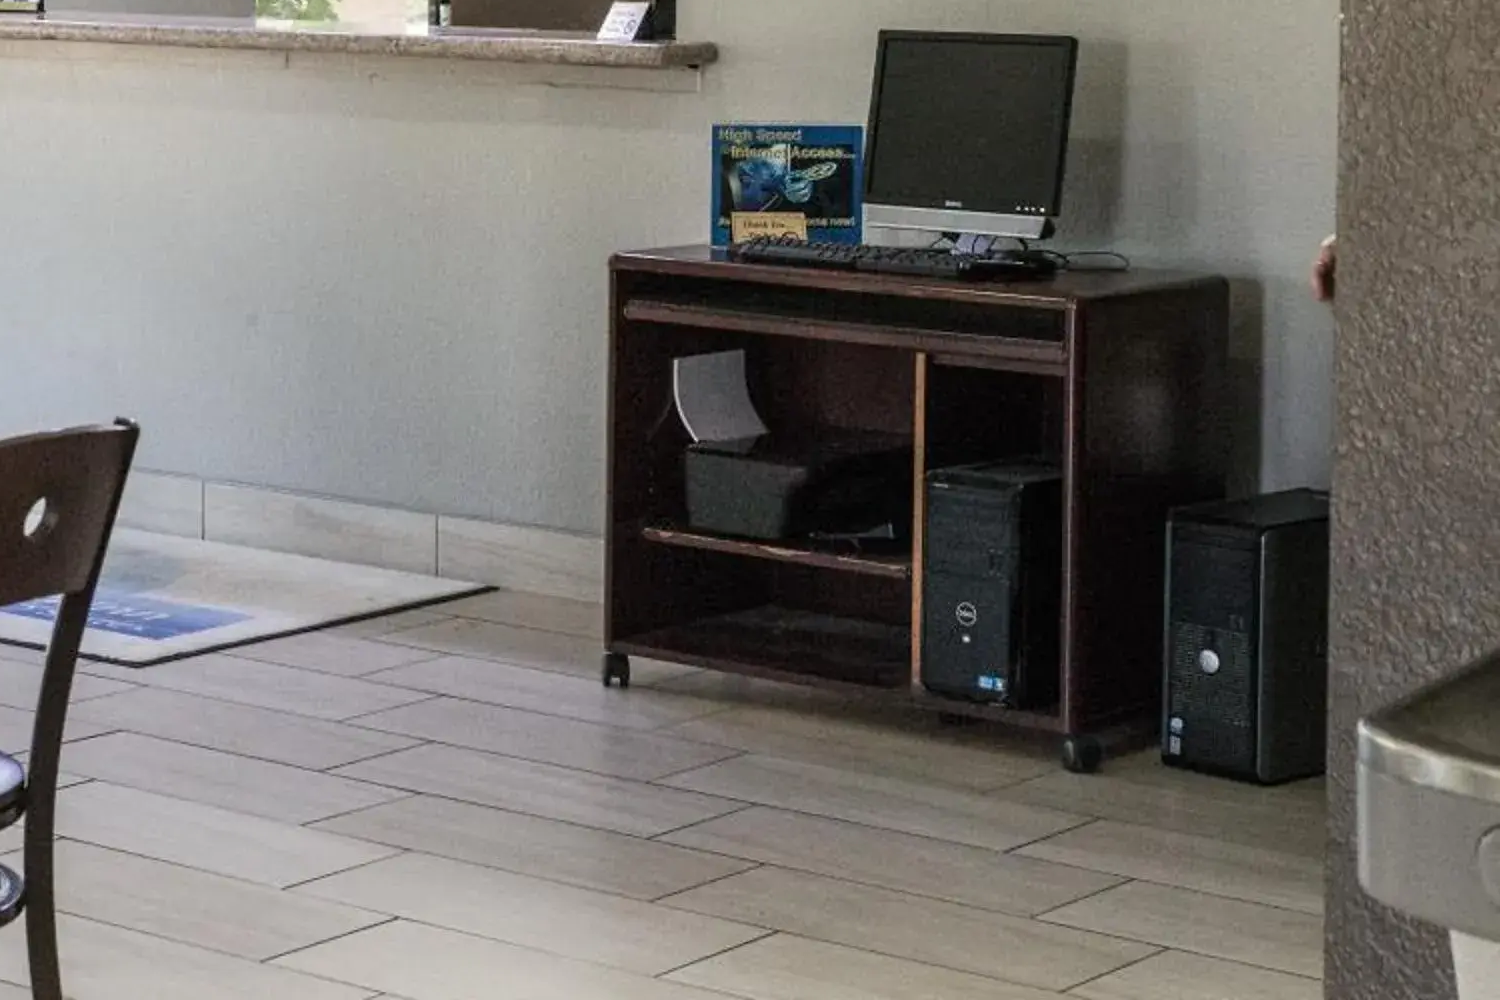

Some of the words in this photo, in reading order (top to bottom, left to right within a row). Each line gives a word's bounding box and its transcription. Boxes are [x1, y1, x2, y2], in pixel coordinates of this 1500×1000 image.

[718, 127, 753, 144] High
[755, 128, 802, 143] Speed
[731, 146, 787, 160] Internet
